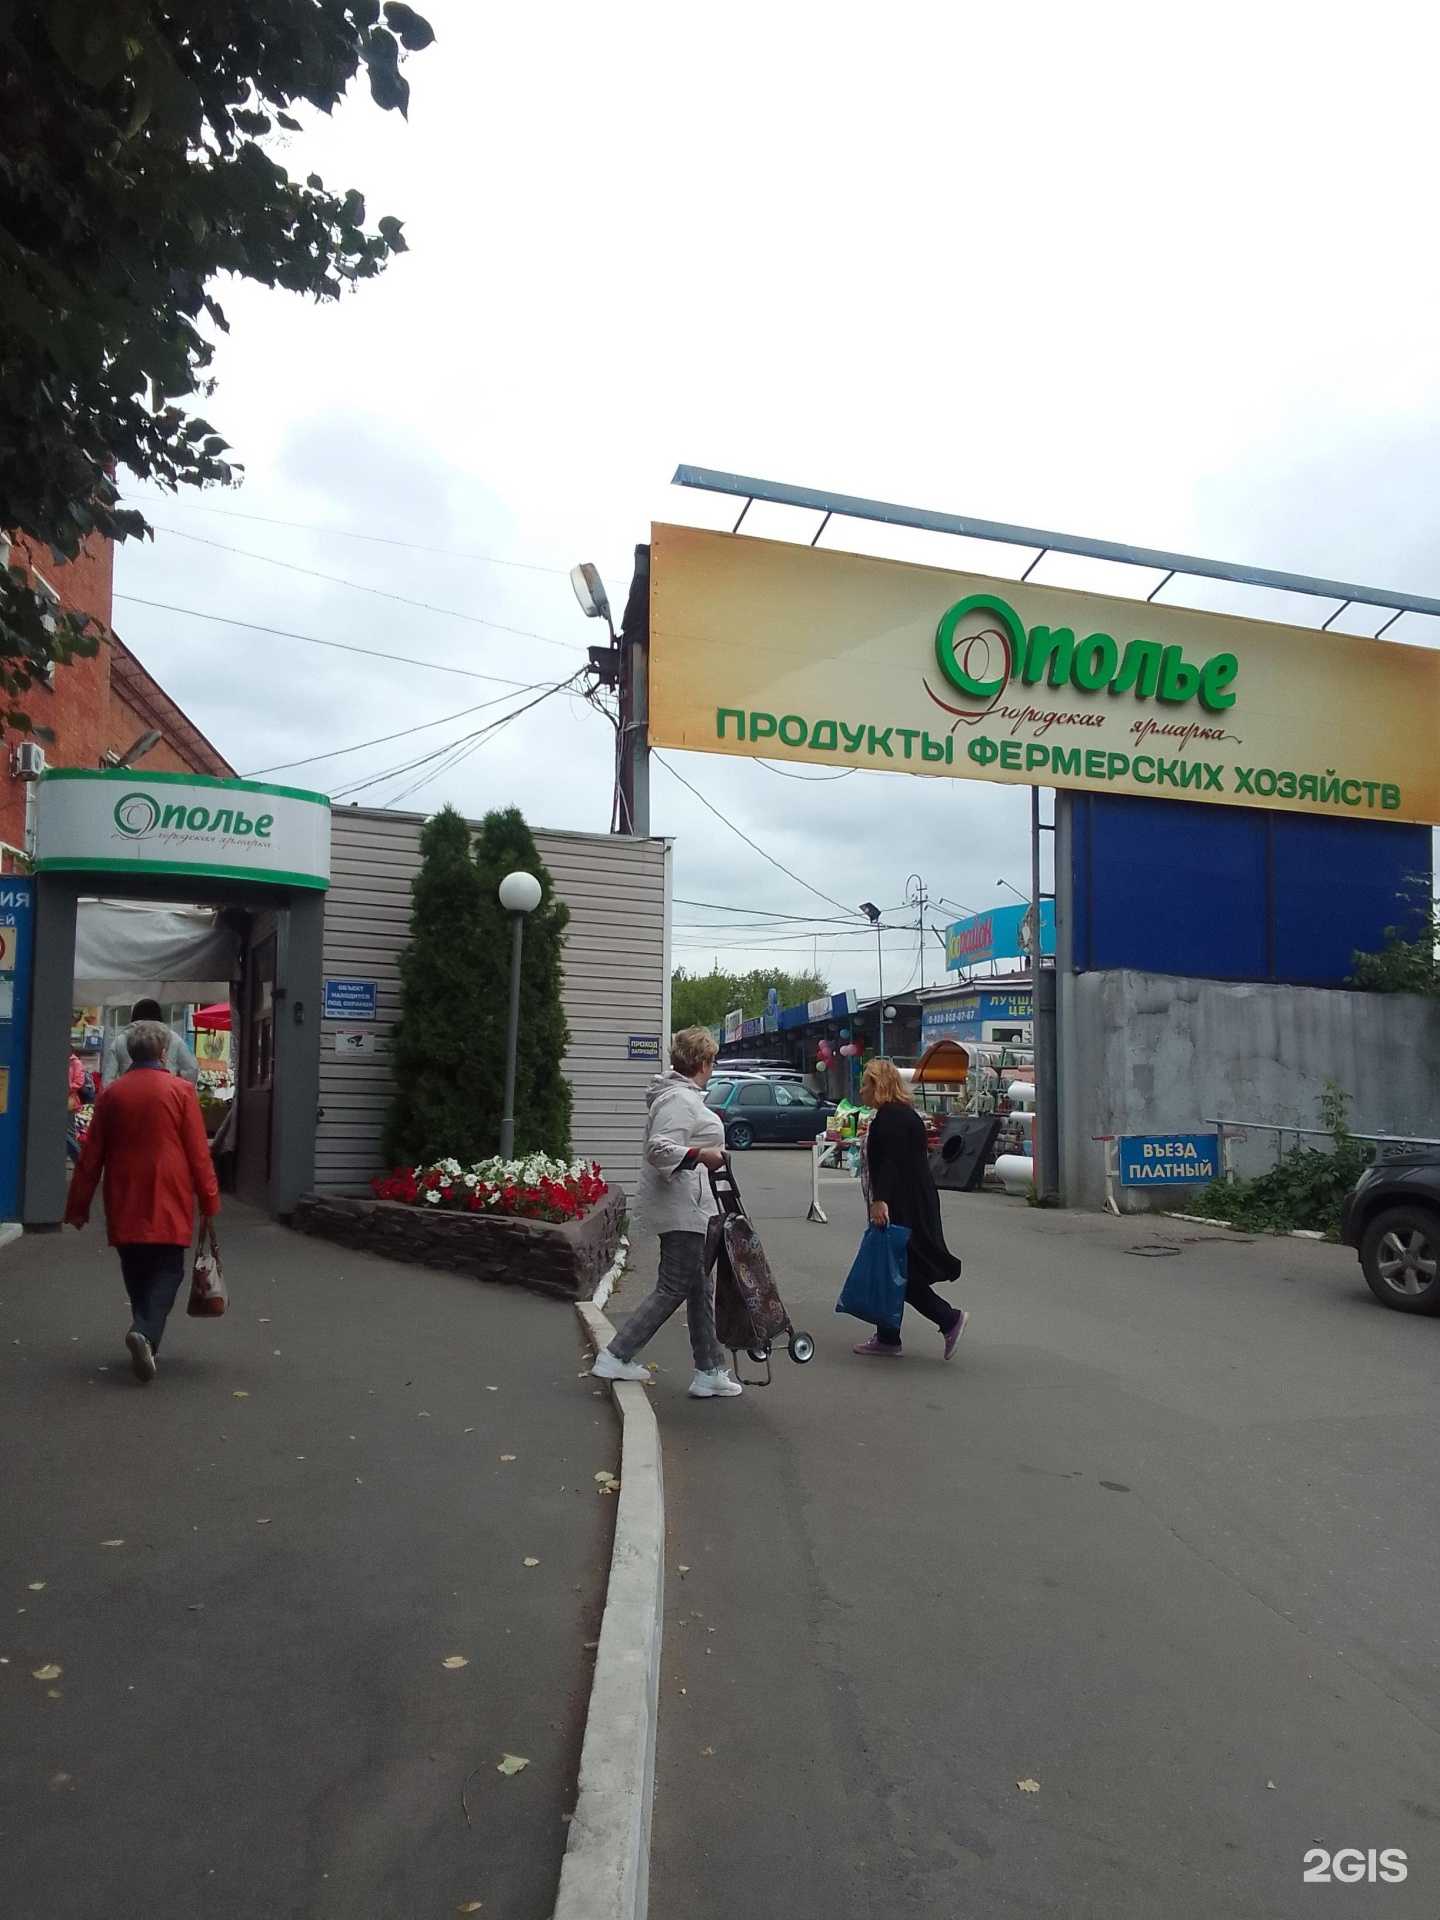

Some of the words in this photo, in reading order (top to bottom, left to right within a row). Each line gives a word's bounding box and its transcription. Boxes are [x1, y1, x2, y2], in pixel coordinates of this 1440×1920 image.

[934, 593, 1239, 712] Ополье
[998, 703, 1107, 737] городская
[1130, 718, 1242, 753] ярмарка
[716, 707, 954, 764] ПРОДУКТЫ
[967, 735, 1224, 792] ФЕРМЕРСКИХ
[1233, 766, 1402, 811] ХОЗЯЙСТВ
[113, 792, 274, 838] Ополье
[989, 996, 1033, 1006] ЛУЧШ
[1008, 1005, 1034, 1017] ЦЕН
[1143, 1142, 1198, 1158] ВЪЕЗД
[1128, 1158, 1213, 1178] ПЛАТНЫЙ
